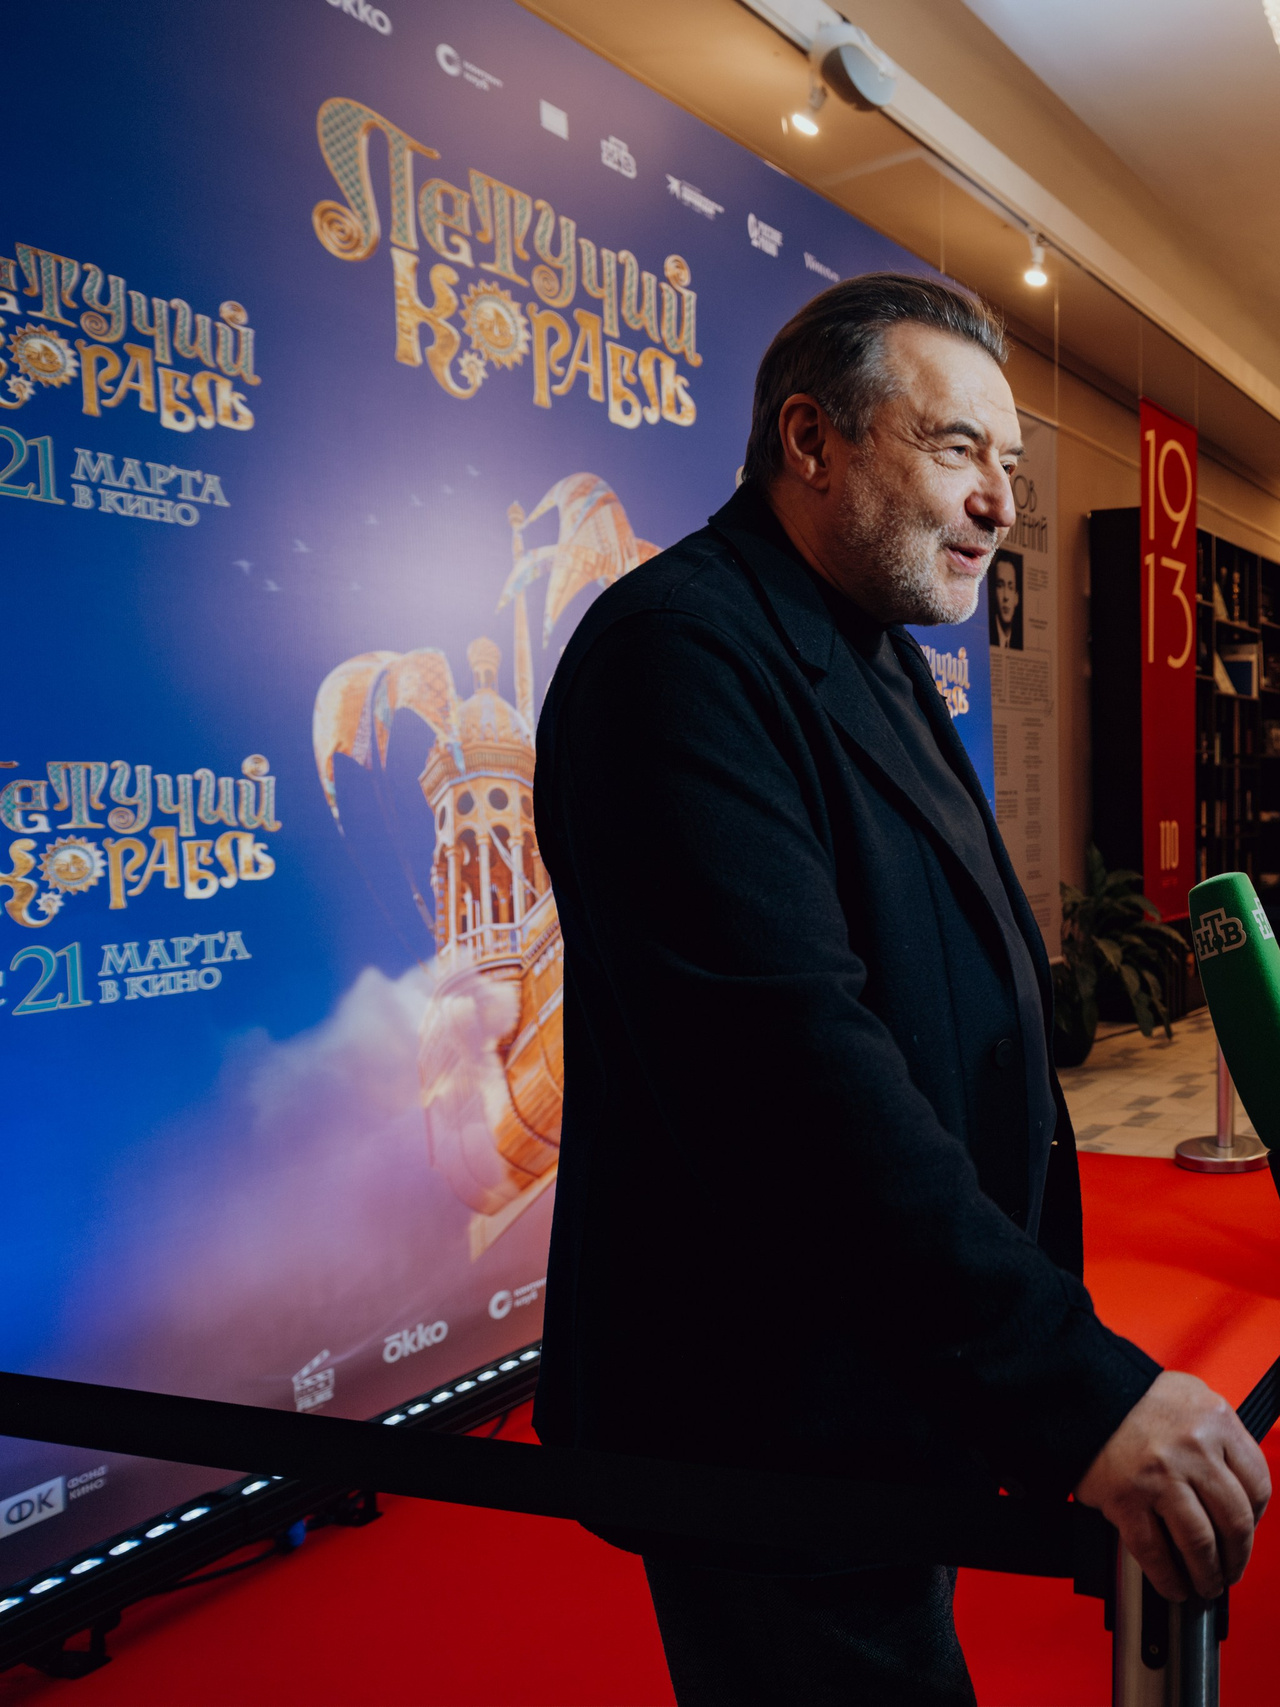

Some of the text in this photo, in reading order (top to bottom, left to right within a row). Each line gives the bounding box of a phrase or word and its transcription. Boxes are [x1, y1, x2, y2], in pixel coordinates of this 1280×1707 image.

[71, 447, 231, 508] МАРТА
[1145, 429, 1193, 549] 19
[71, 483, 200, 527] В КИНО
[1145, 553, 1194, 670] 13
[1195, 910, 1244, 958] НТВ
[10, 931, 252, 1016] 21 МАРТА
[98, 967, 222, 1004] В КИНО
[5, 1487, 54, 1525] ФК
